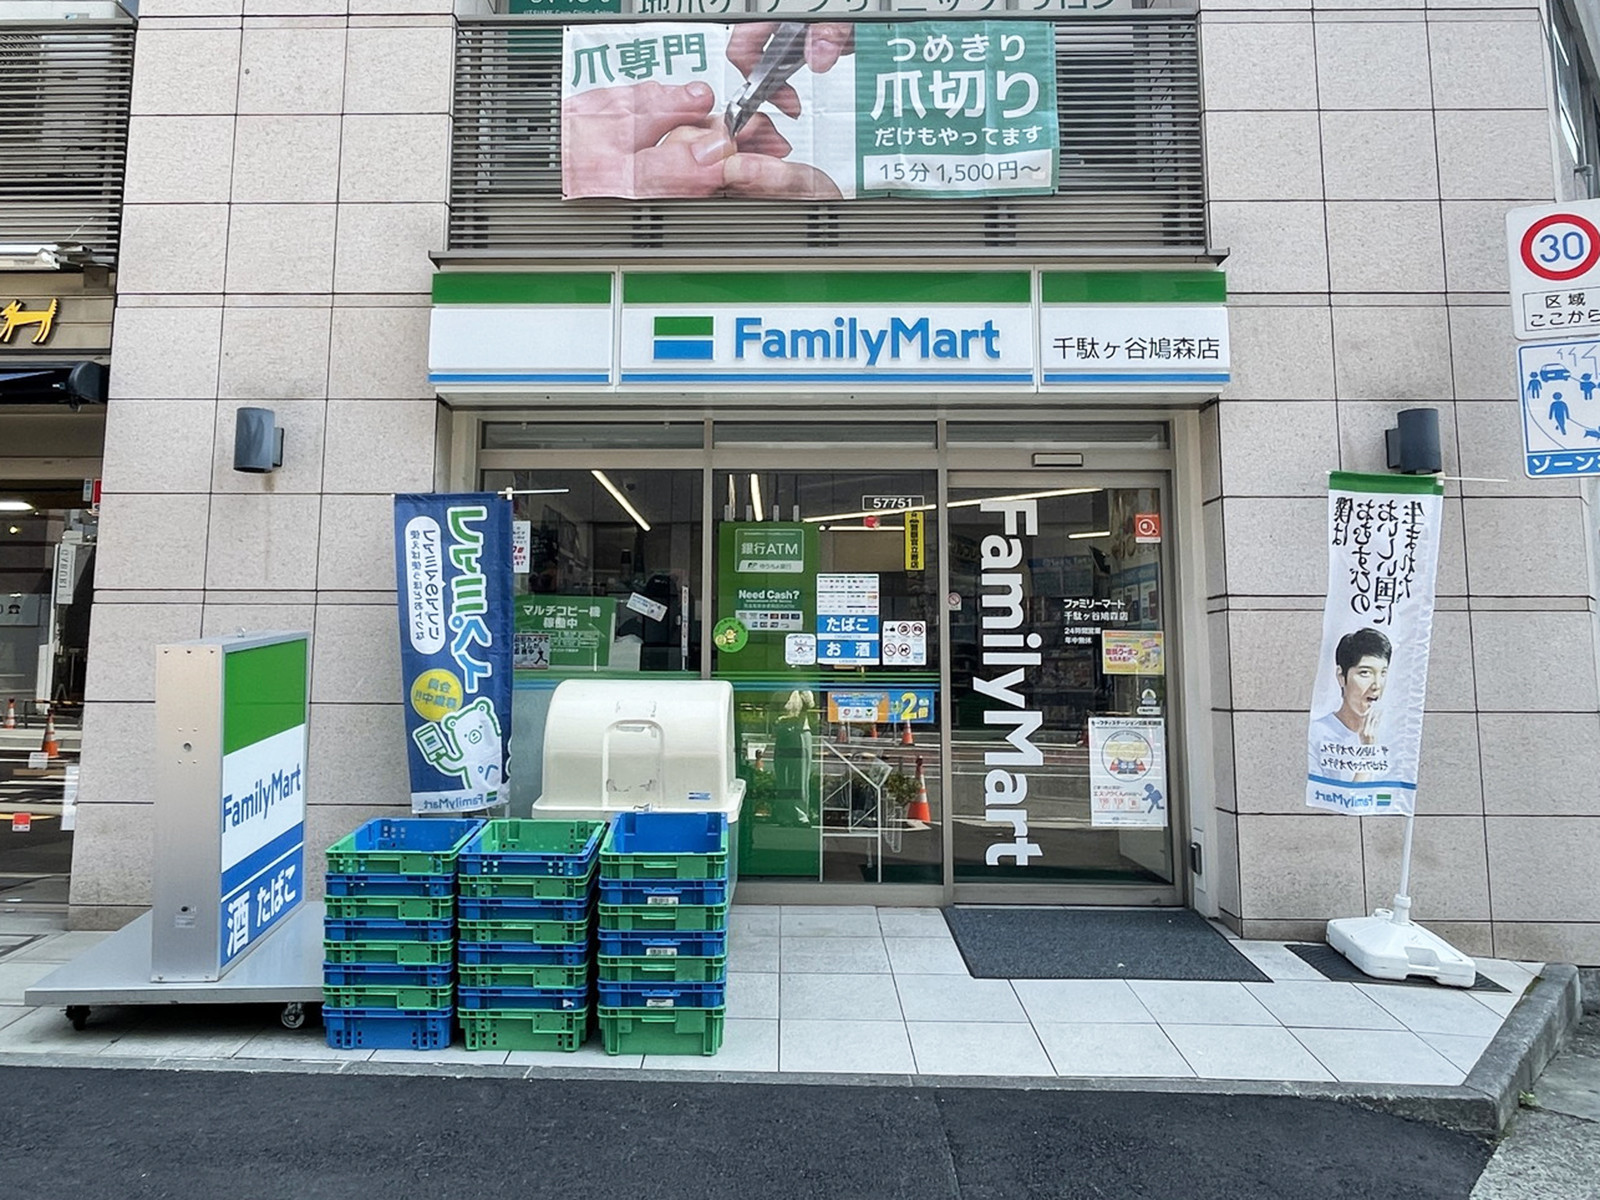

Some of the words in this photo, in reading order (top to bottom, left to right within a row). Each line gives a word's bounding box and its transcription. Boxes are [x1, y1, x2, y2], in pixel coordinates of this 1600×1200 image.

[887, 33, 1027, 62] つめきり
[571, 33, 708, 87] 爪専門
[870, 69, 1041, 121] 爪切り
[874, 125, 1042, 149] だけもやってます
[1539, 231, 1584, 263] 30
[1545, 292, 1585, 308] 区域
[1530, 309, 1600, 327] ここから
[734, 316, 1001, 368] FamilyMart
[1053, 336, 1220, 361] 千駄ヶ谷鳩森店
[1531, 455, 1600, 474] ゾーン
[873, 498, 912, 508] 57751
[741, 542, 798, 555] 銀行ATM
[738, 589, 765, 599] Need
[767, 589, 800, 600] Cash?
[1063, 598, 1126, 609] ファミリーマート
[523, 605, 601, 617] マルチコピー機
[826, 617, 870, 632] たばこ
[826, 641, 871, 657] お酒
[973, 500, 1044, 867] FamilyMart
[223, 762, 302, 834] FamilyMart
[226, 890, 251, 957] 酒
[256, 864, 296, 929] たばこ
